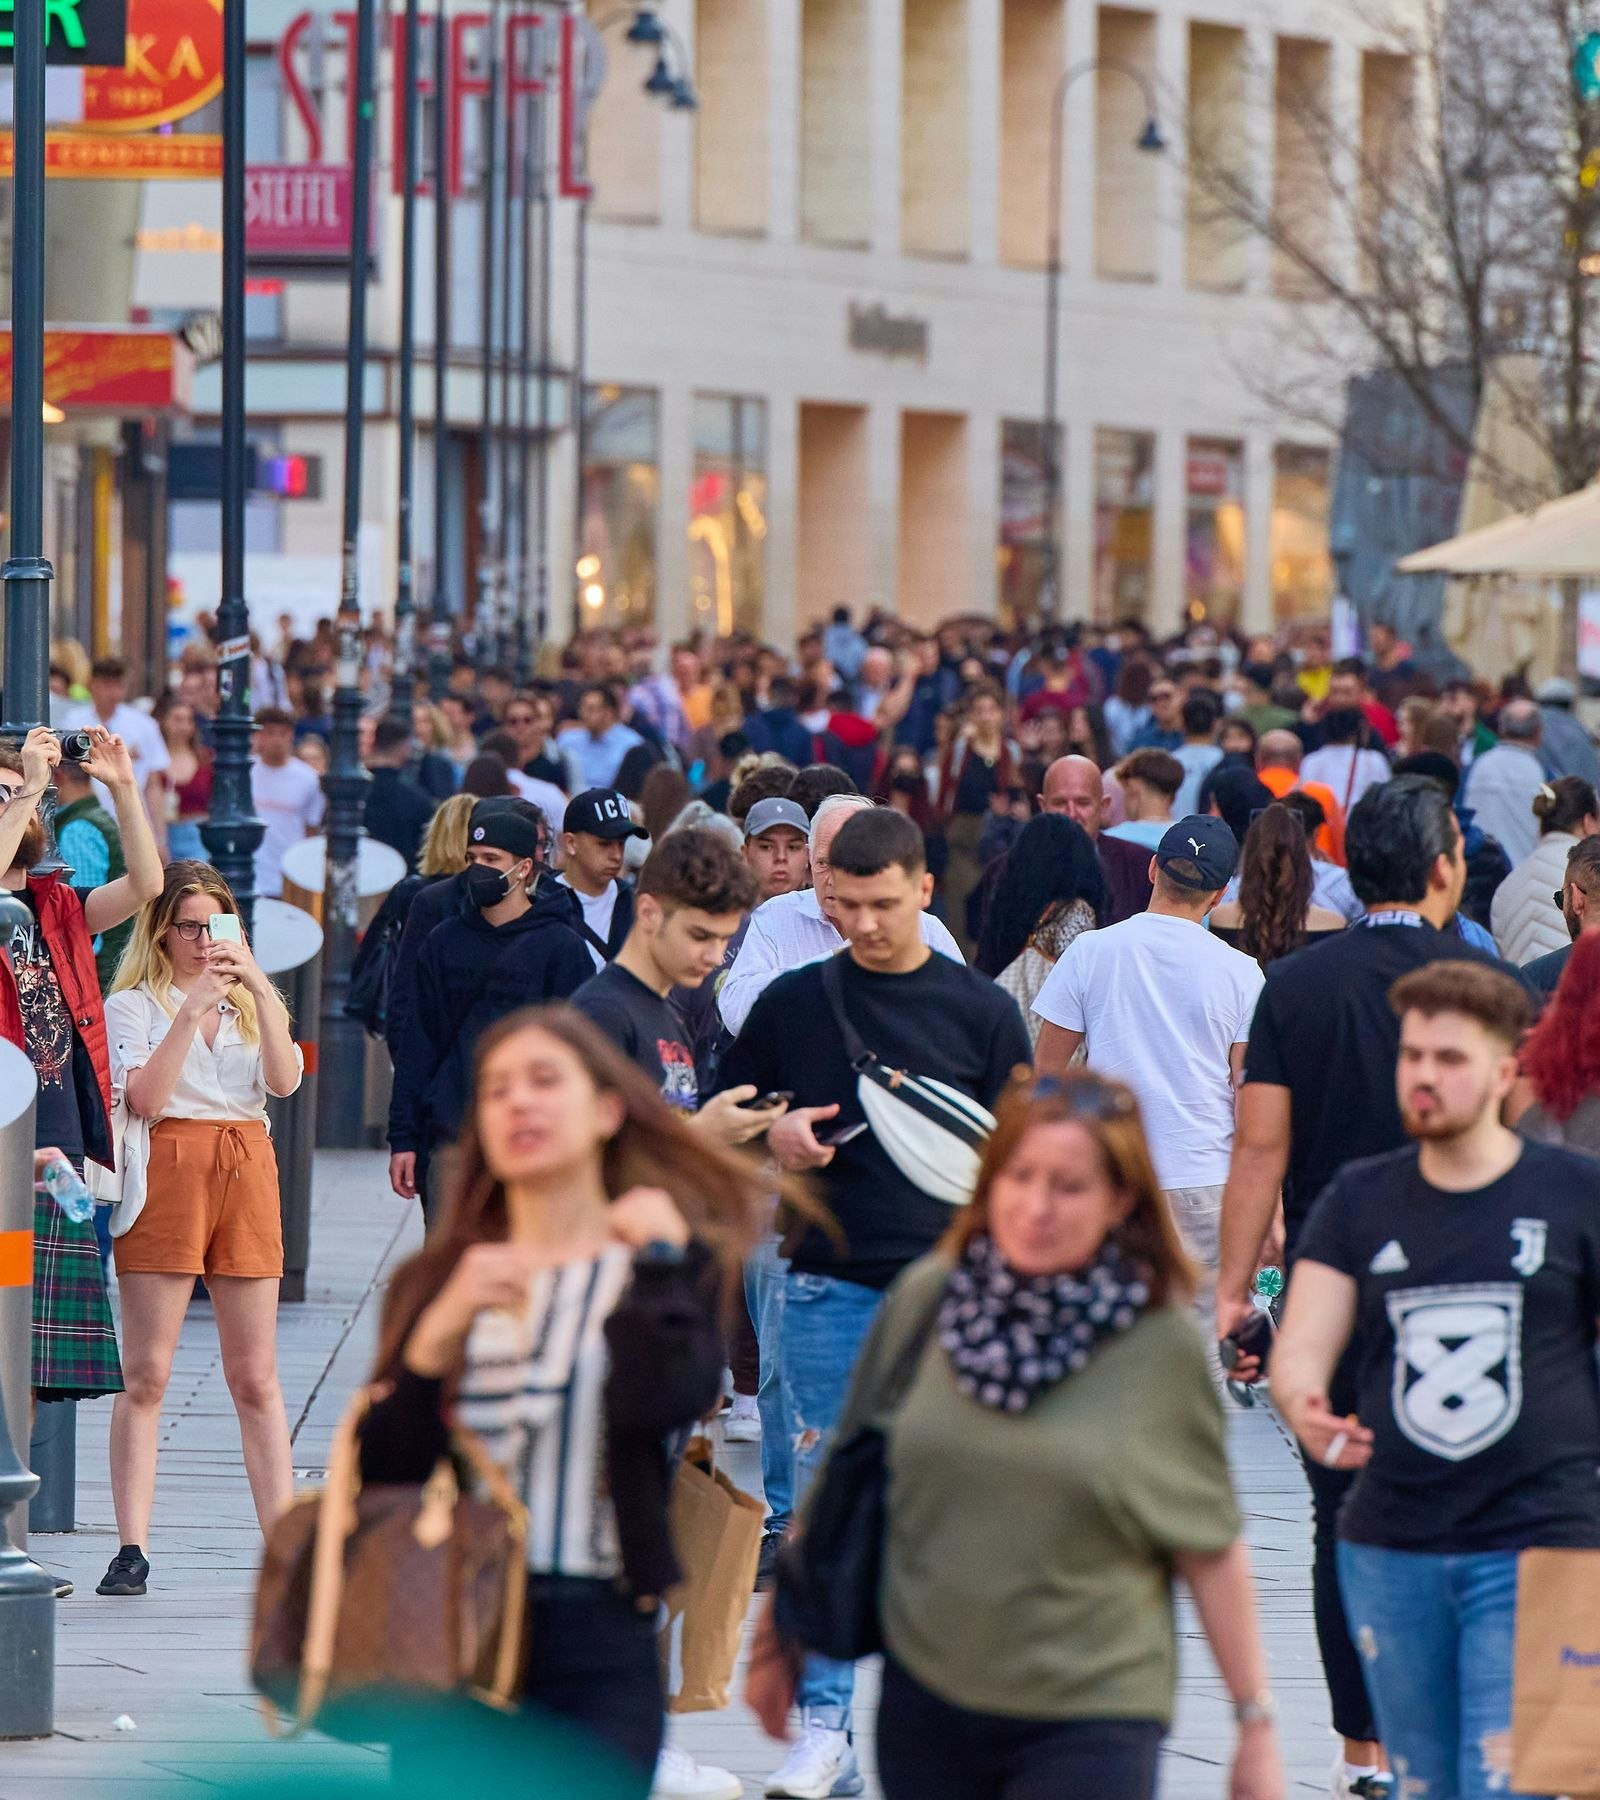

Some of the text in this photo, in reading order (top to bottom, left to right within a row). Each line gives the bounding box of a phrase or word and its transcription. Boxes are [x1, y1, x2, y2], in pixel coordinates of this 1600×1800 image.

[280, 12, 592, 198] STEFFL
[245, 174, 341, 227] STEFFL
[593, 792, 632, 822] ICO
